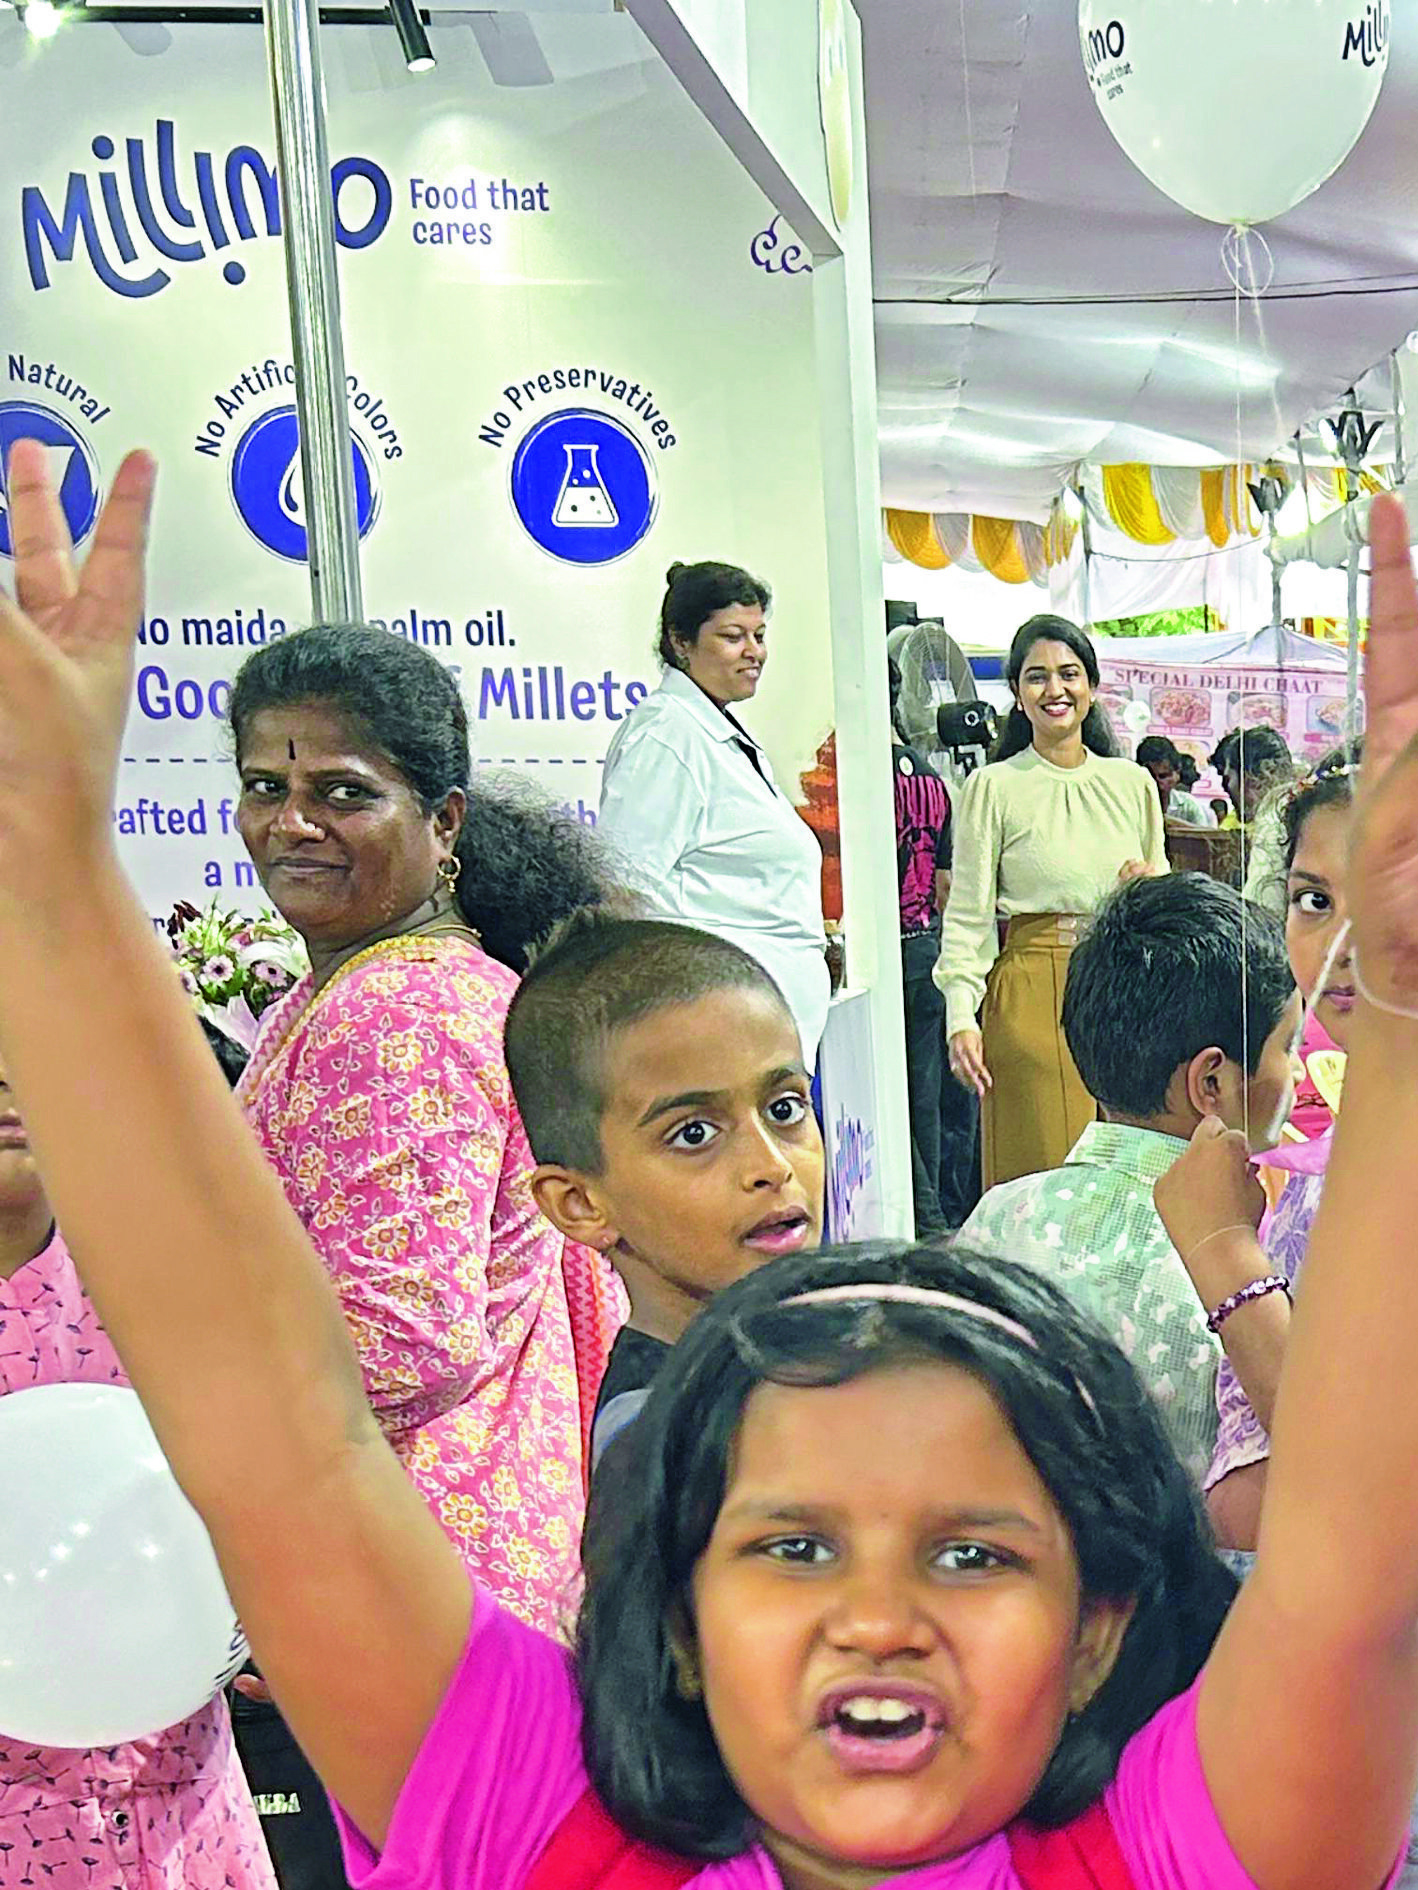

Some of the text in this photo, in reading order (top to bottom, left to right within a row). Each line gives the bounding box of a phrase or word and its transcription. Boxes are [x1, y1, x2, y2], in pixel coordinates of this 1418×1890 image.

[409, 177, 551, 212] Food that
[412, 220, 493, 246] cares
[8, 353, 111, 425] Natural
[194, 420, 226, 458] No
[214, 359, 296, 420] Artific
[478, 367, 677, 450] No Preservatives
[182, 608, 287, 646] maida
[465, 609, 516, 647] oil.
[478, 665, 648, 721] Millets
[1114, 668, 1323, 694] SPECIAL DELHI CHAAT
[113, 797, 207, 836] afted
